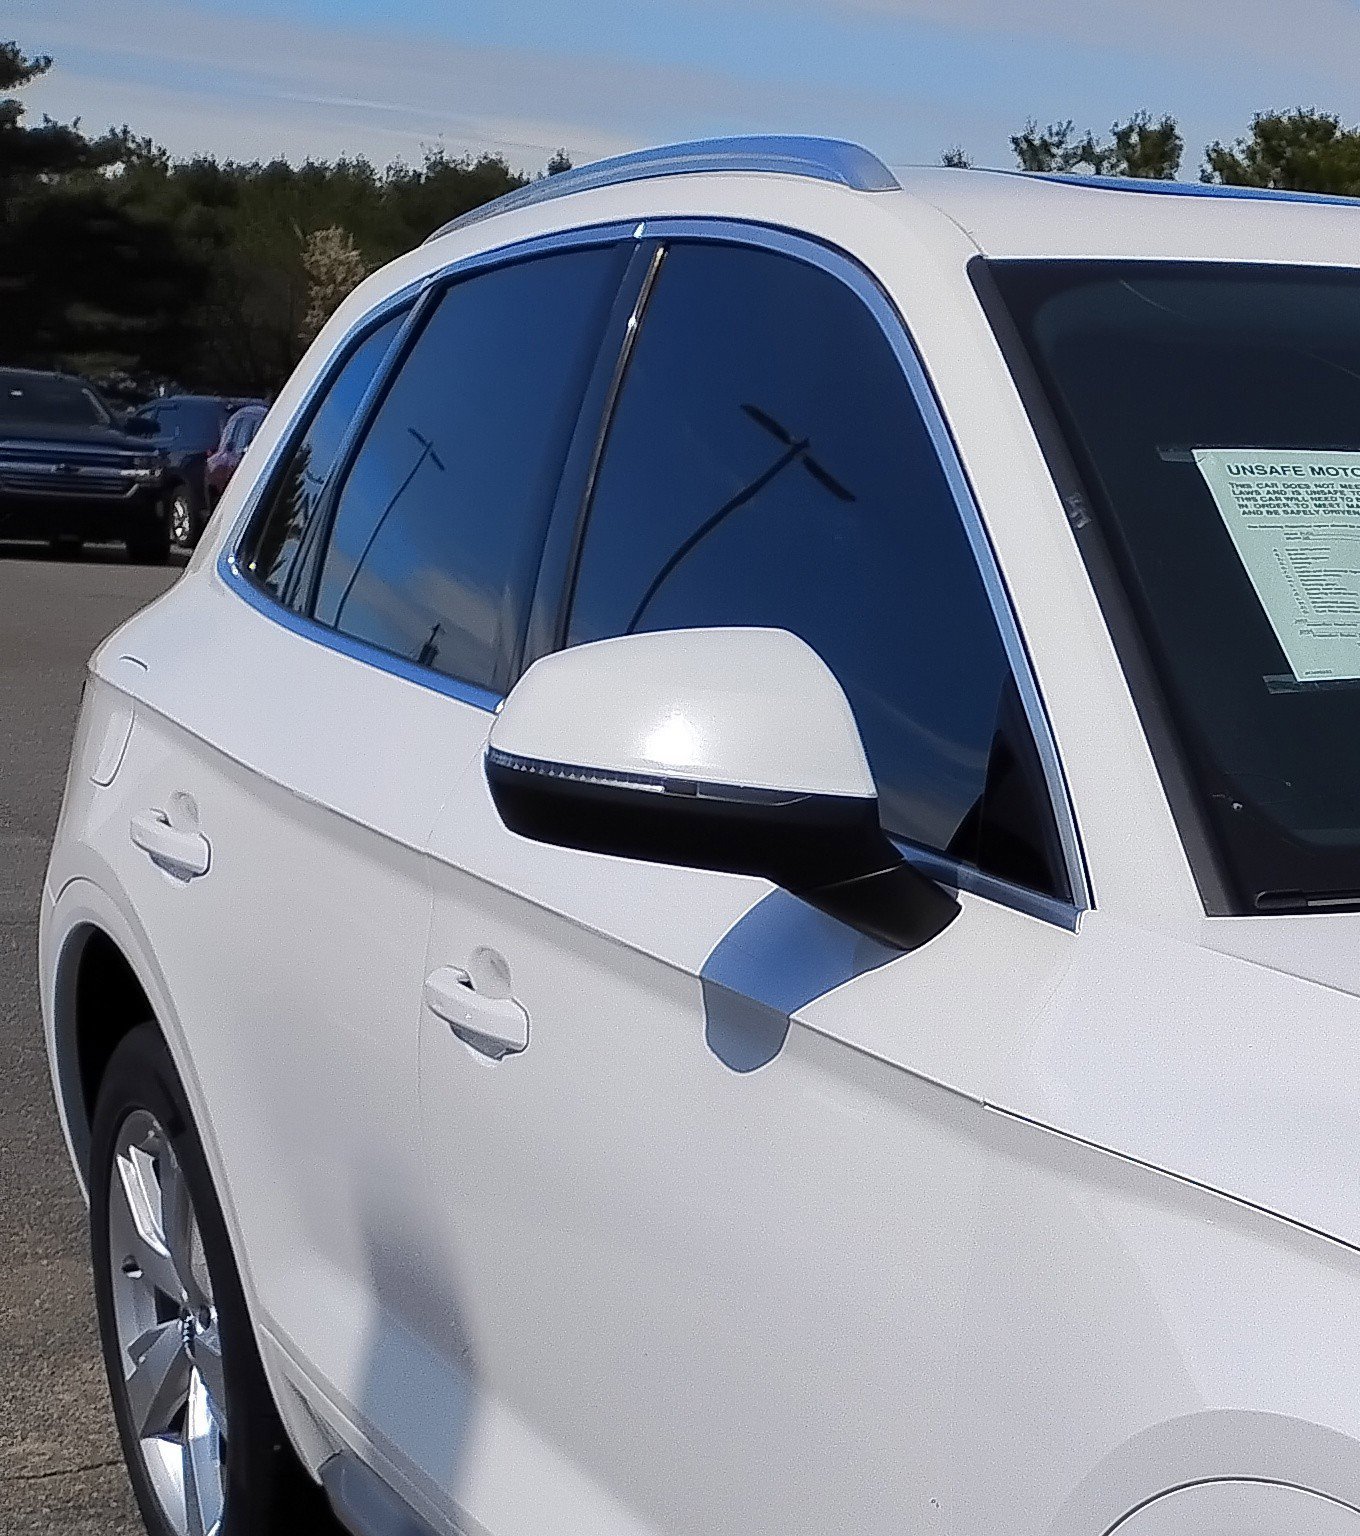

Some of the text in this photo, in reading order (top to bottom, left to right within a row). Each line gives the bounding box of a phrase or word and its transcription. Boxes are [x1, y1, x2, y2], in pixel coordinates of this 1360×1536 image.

[1226, 464, 1306, 477] UNSAFE
[1282, 482, 1311, 490] DOES
[1305, 489, 1346, 497] UNSAFE
